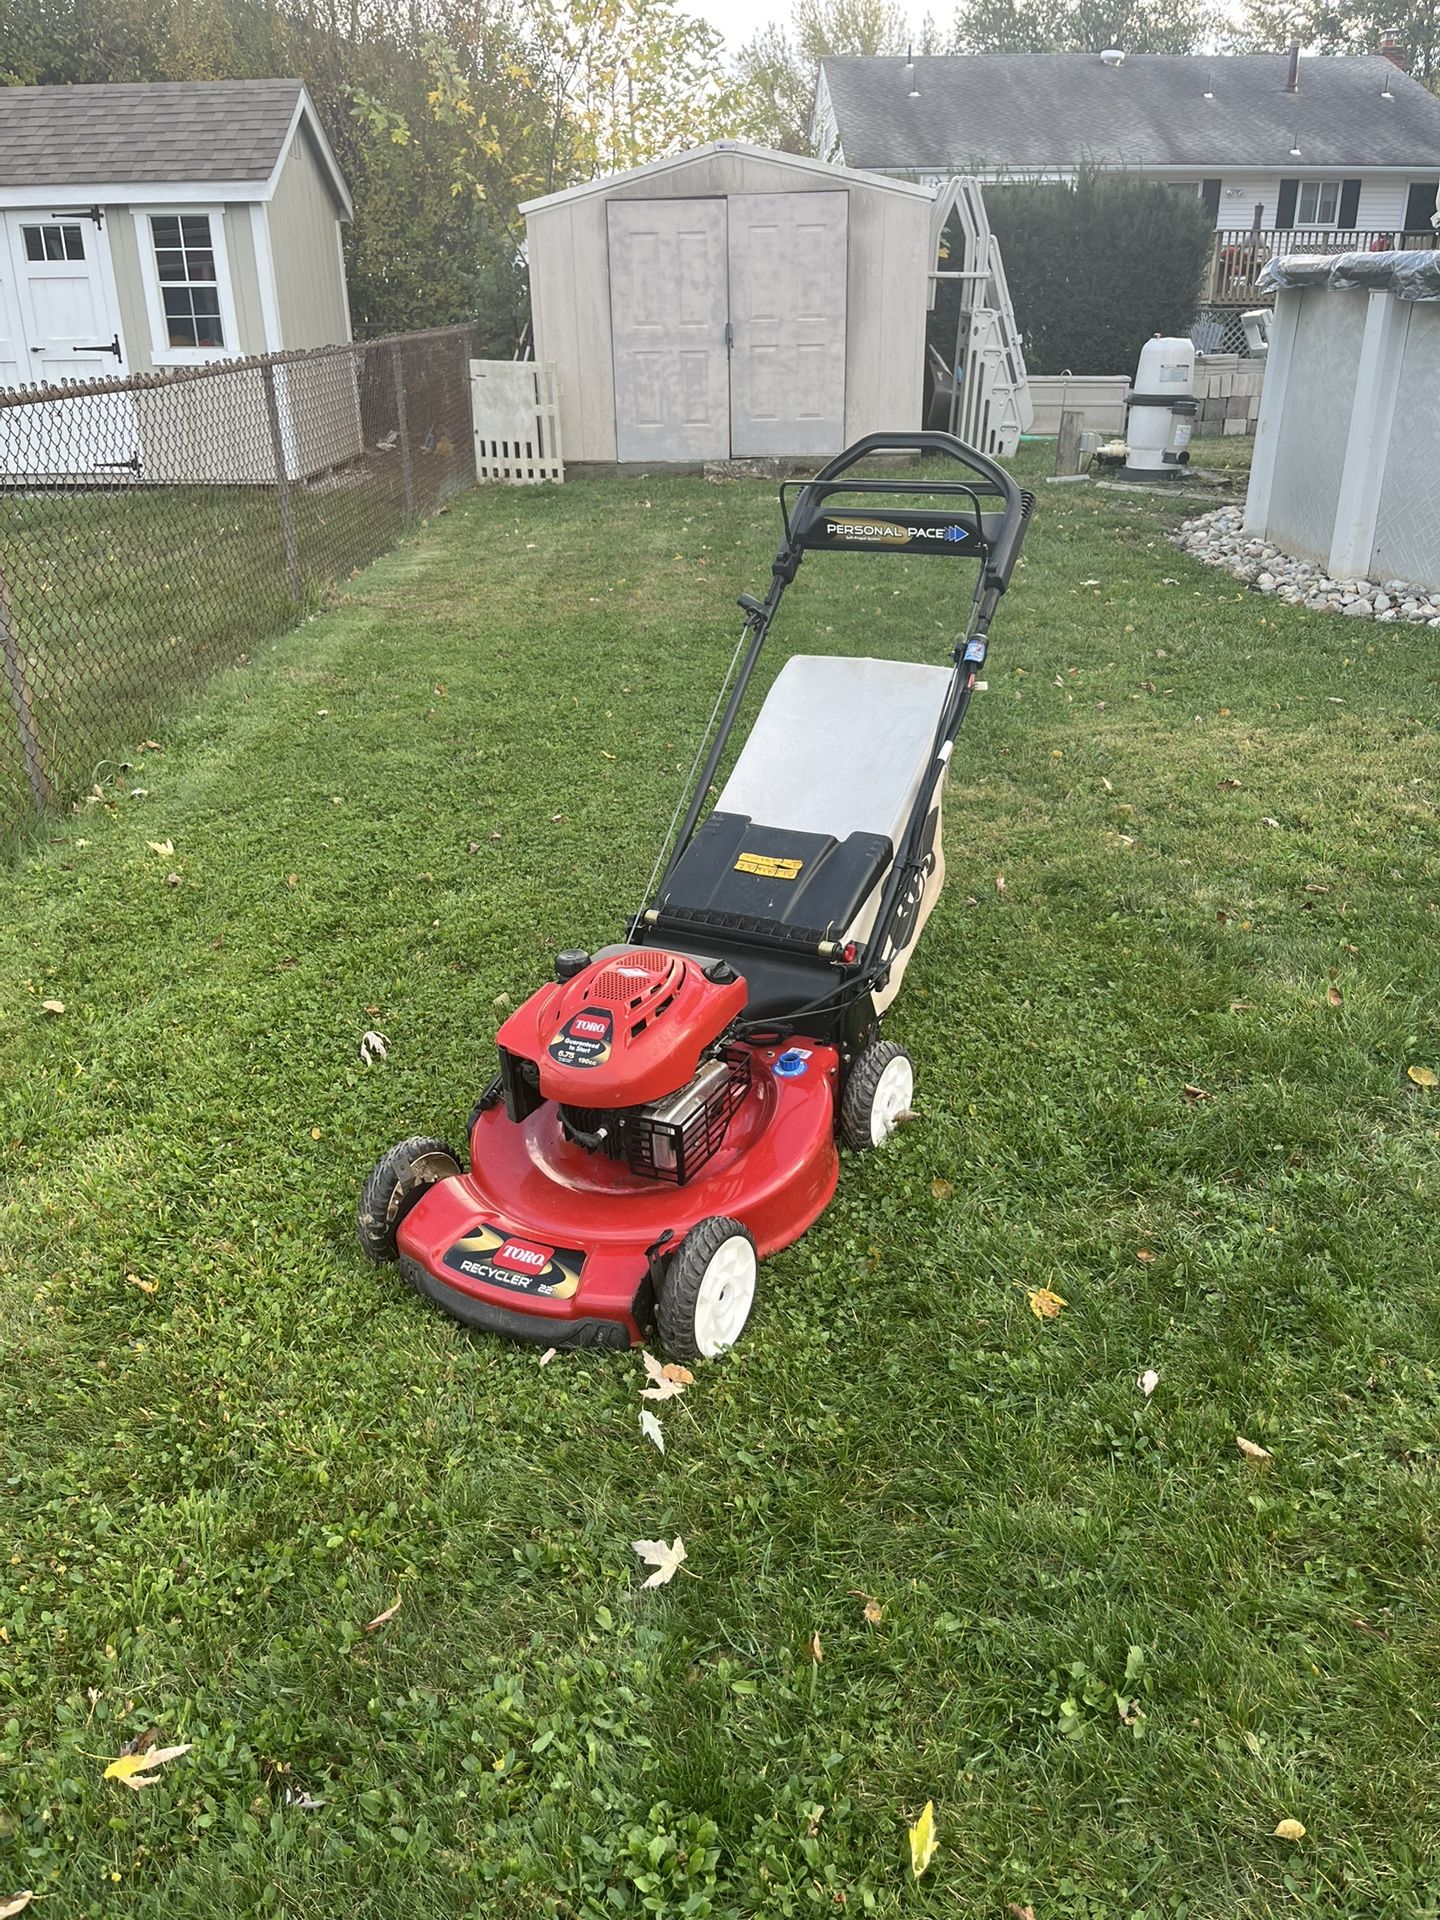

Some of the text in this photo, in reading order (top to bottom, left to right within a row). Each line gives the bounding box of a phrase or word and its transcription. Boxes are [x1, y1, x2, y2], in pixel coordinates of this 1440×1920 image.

[827, 524, 945, 539] PERSONAL PACE
[576, 1020, 605, 1033] TORO
[564, 1038, 600, 1049] Guaranteed
[578, 1057, 597, 1066] 190cc
[503, 1245, 545, 1267] TORO
